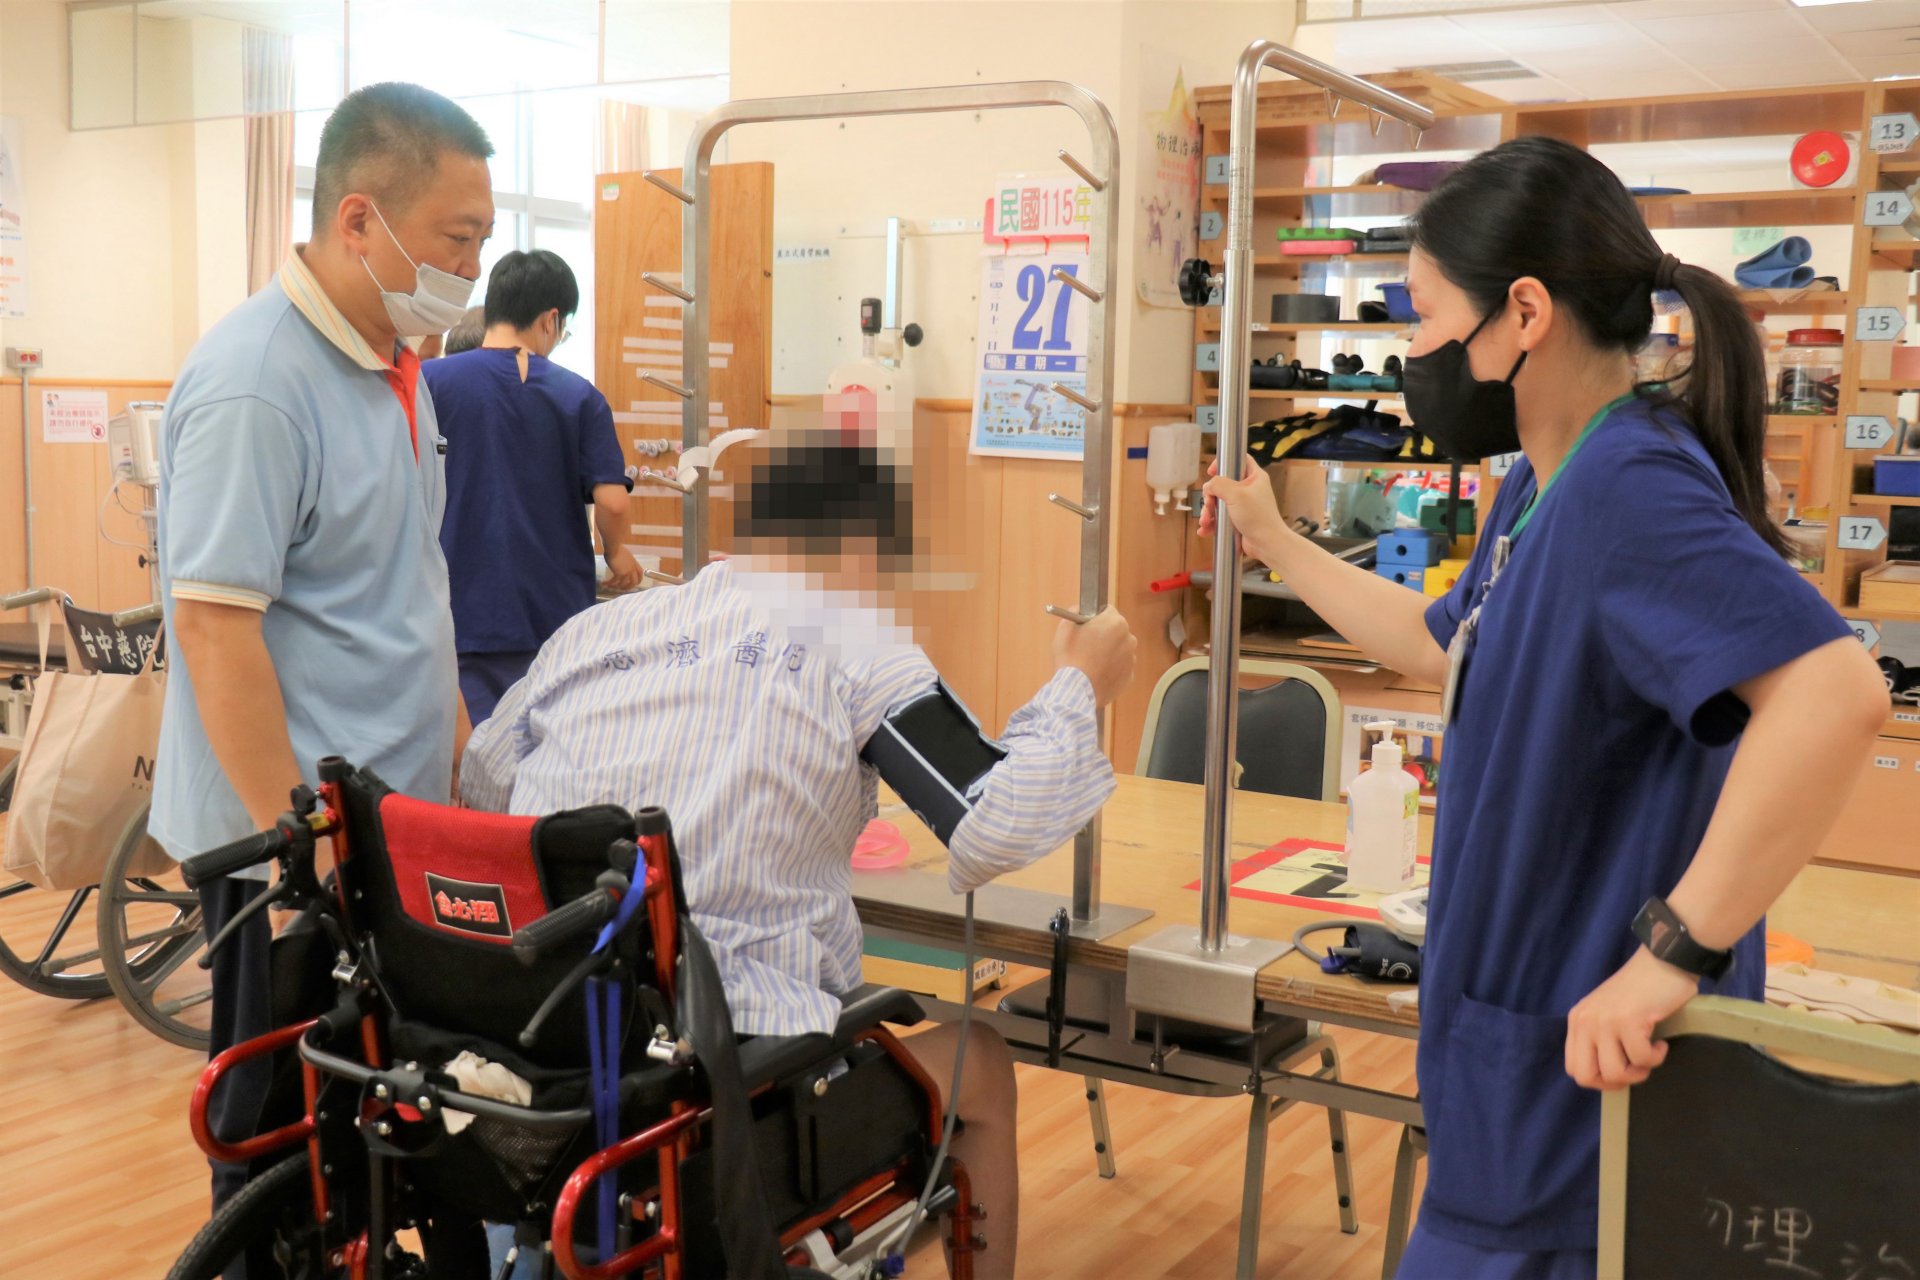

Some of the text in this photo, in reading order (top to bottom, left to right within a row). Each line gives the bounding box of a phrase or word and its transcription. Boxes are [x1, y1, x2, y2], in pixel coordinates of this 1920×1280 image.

[1881, 123, 1905, 139] 13
[1218, 163, 1224, 176] 1
[998, 185, 1091, 232] 民國115年
[1875, 200, 1899, 216] 14
[1208, 219, 1214, 232] 2
[1012, 264, 1078, 350] 27
[1867, 315, 1890, 331] 15
[1014, 355, 1068, 371] 星期一
[1207, 350, 1216, 363] 4
[1207, 413, 1215, 425] 5
[1856, 424, 1879, 440] 16
[1849, 525, 1872, 540] 17
